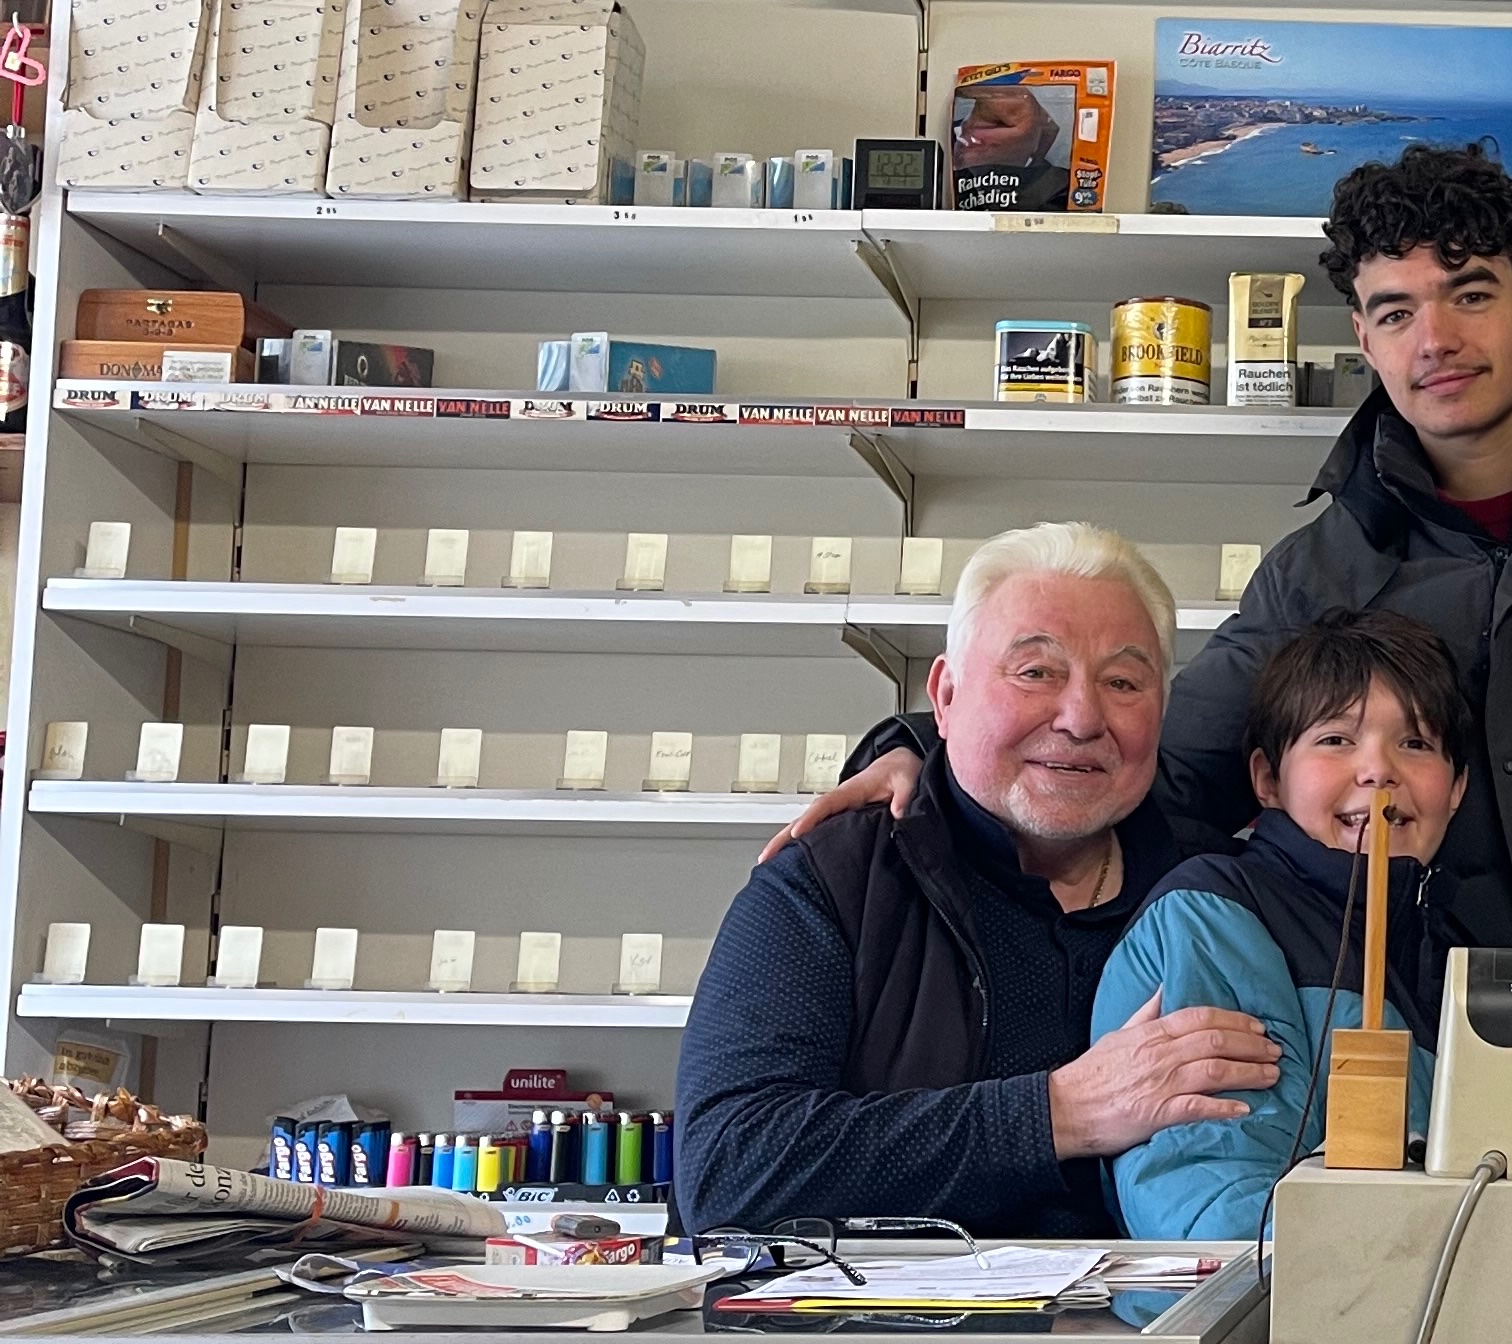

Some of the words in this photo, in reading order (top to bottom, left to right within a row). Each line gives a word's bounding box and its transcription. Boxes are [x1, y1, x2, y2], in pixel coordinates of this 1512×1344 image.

[1179, 33, 1283, 63] Biarritz
[1214, 58, 1262, 70] BASQUE
[958, 171, 1020, 193] Rauchen
[958, 188, 1018, 211] schädigt
[126, 318, 193, 329] PARTAGAS
[100, 363, 130, 376] DON
[1238, 368, 1291, 379] Rauchen
[1236, 382, 1250, 392] ist
[1253, 381, 1293, 392] tödlich
[67, 389, 117, 401] DRUM
[144, 391, 194, 403] DRUM
[316, 395, 359, 410] NELLE
[363, 397, 391, 412] VAN
[393, 398, 433, 413] NELLE
[438, 400, 467, 413] VAN
[468, 401, 509, 414] NELLE
[599, 401, 647, 413] DRUM
[675, 404, 726, 416] DRUM
[740, 407, 770, 419] VAN
[772, 407, 813, 420] NELLE
[817, 408, 847, 421] VAN
[849, 408, 888, 422] NELLE
[893, 409, 922, 422] VAN
[924, 409, 964, 424] NELLE
[510, 1075, 556, 1090] unilite
[274, 1136, 291, 1179] Fargo
[296, 1142, 313, 1182] Fargo
[318, 1143, 335, 1183] Fargo
[351, 1144, 369, 1183] Fargo
[518, 1191, 550, 1202] BIC
